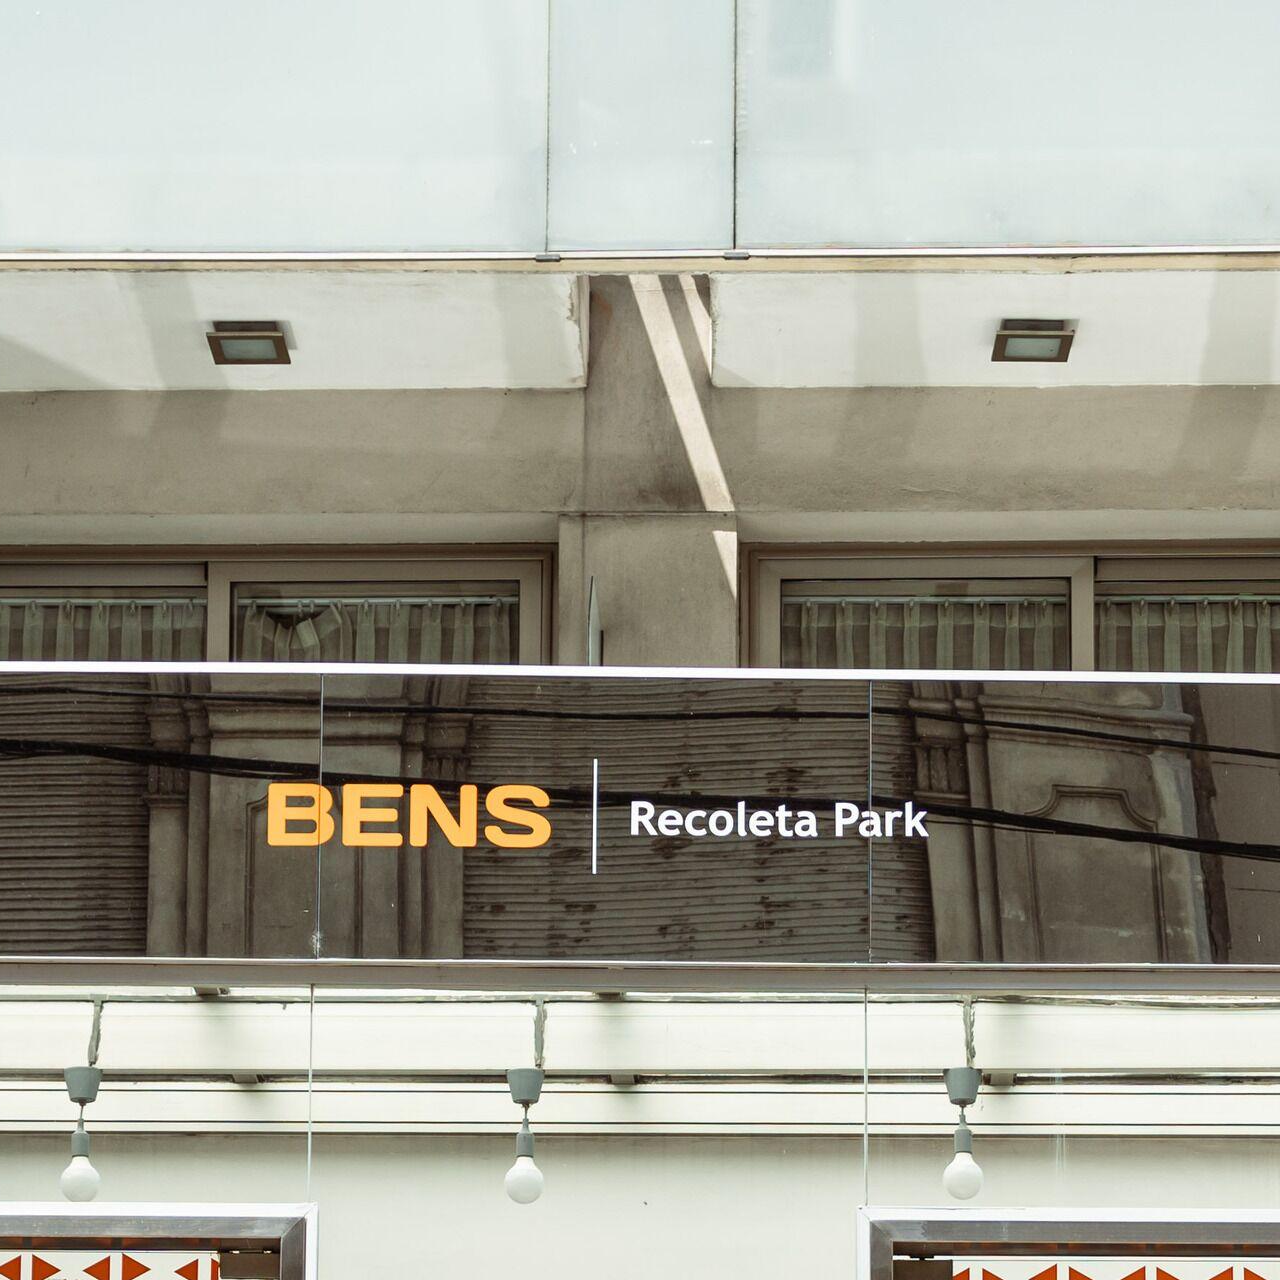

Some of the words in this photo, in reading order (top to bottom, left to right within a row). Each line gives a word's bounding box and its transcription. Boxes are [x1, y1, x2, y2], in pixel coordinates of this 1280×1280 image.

[266, 782, 551, 848] BENS
[629, 800, 818, 838] Recoleta
[834, 801, 930, 838] Park
